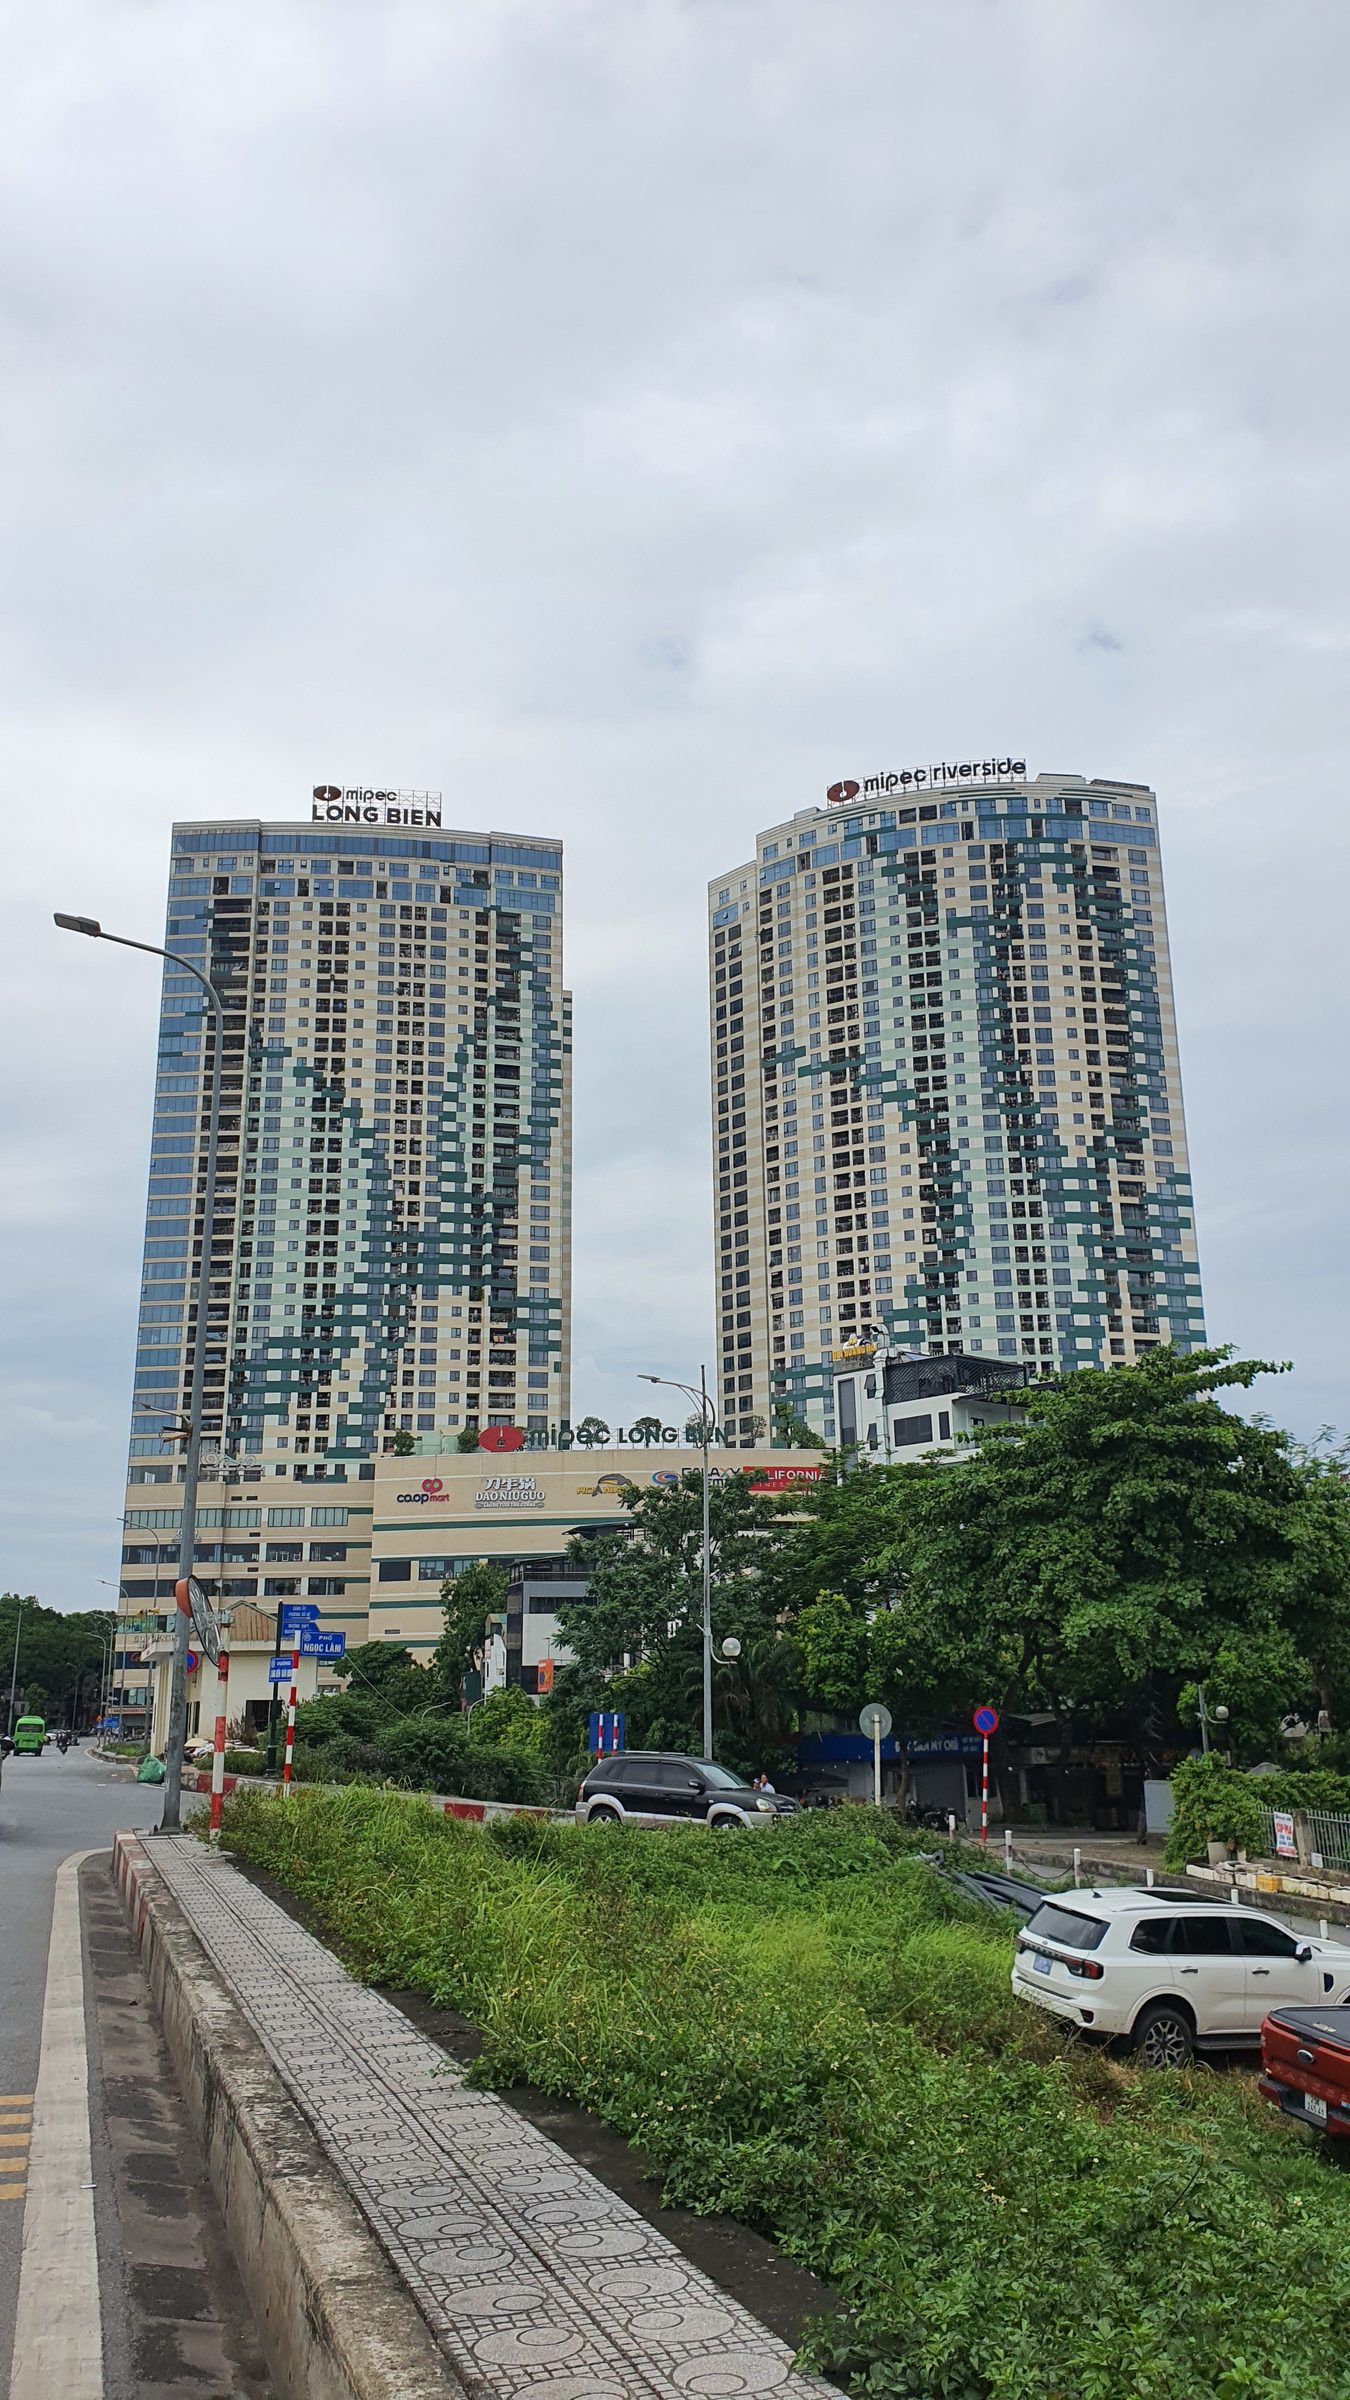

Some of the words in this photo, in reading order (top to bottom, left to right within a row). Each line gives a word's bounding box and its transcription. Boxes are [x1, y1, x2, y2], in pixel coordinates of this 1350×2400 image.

[865, 769, 926, 791] mipec
[933, 757, 1026, 780] riverside
[346, 787, 397, 802] mipec
[312, 804, 379, 823] LONG
[387, 807, 441, 827] BIEN
[529, 1423, 611, 1450] mipec
[619, 1426, 678, 1443] LONG
